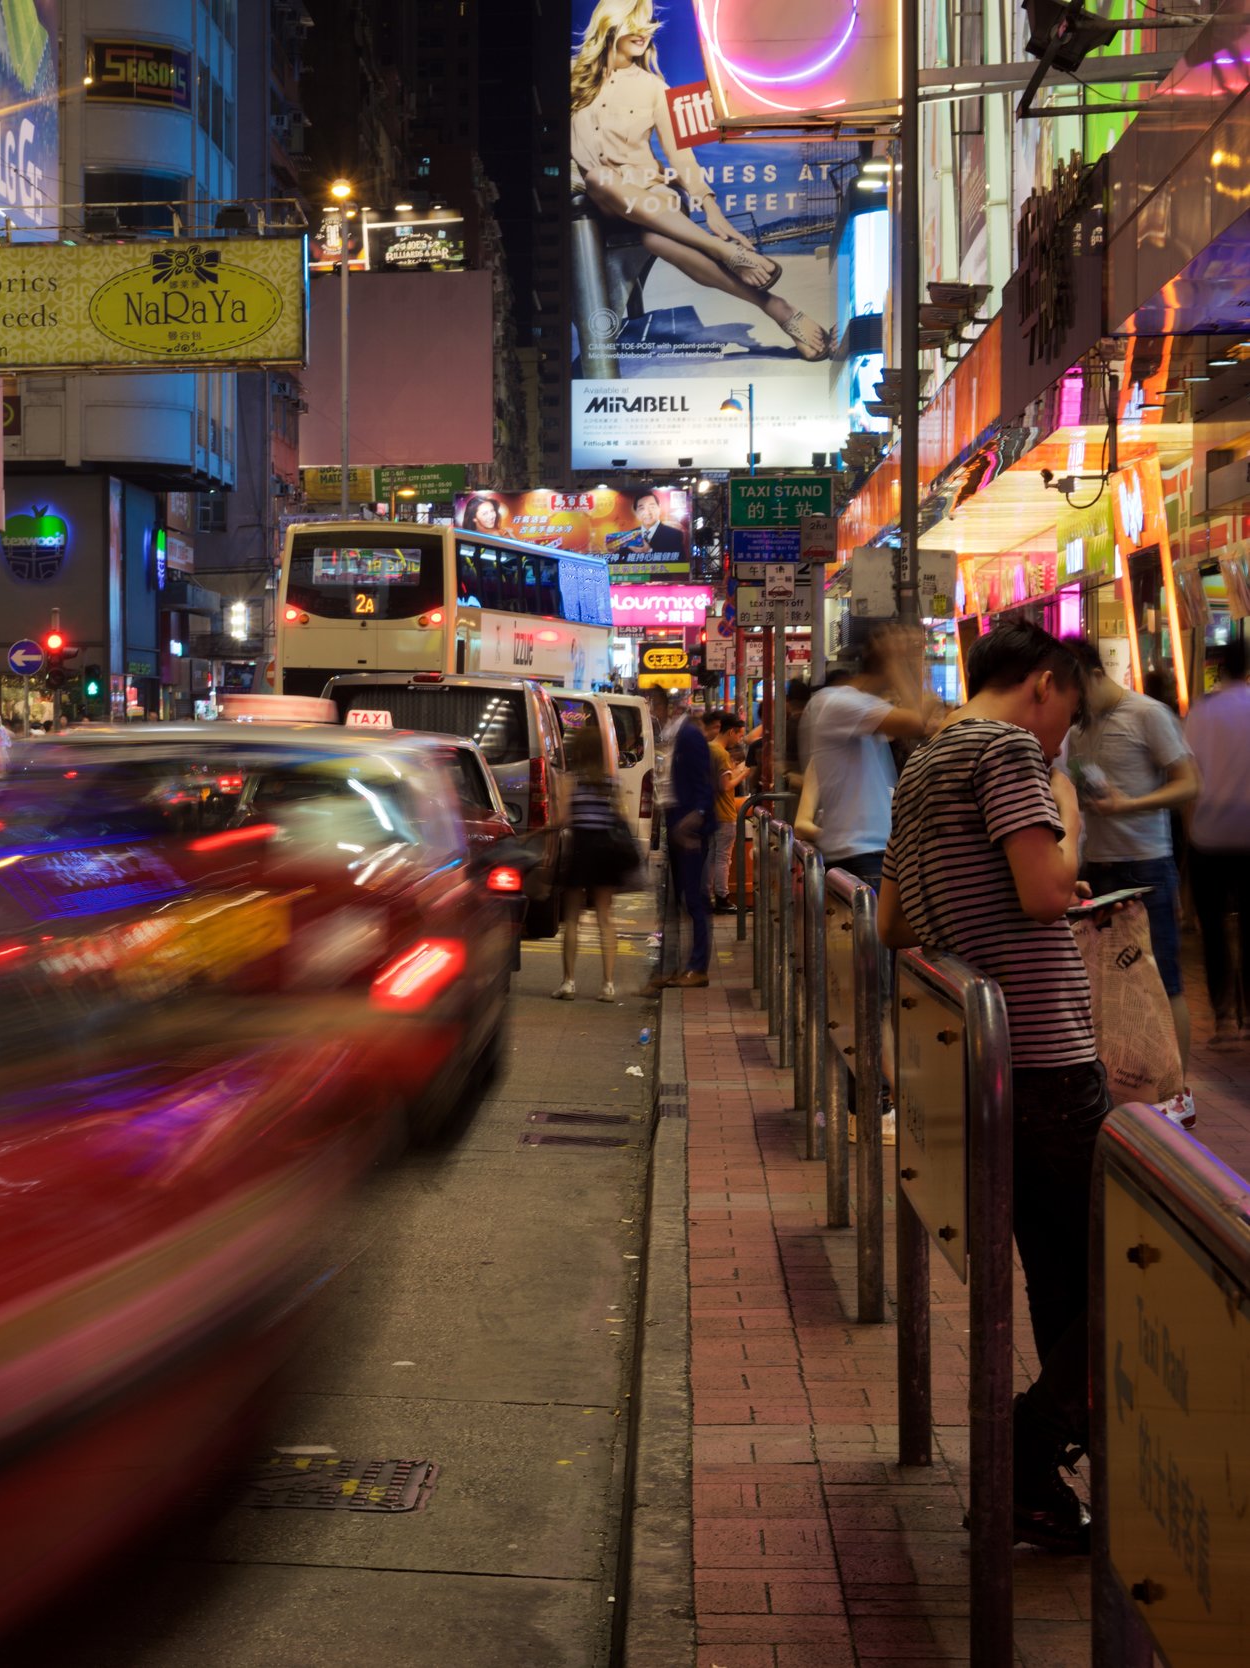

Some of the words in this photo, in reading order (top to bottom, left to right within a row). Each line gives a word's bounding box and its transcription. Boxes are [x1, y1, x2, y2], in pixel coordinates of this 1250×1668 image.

[598, 163, 778, 187] HAPPINESS
[799, 163, 832, 182] AT
[625, 193, 704, 215] YOUR
[725, 191, 798, 212] FEET
[124, 289, 248, 327] NaRaYa
[621, 342, 655, 350] TOE-POST
[656, 342, 672, 350] with
[672, 342, 725, 352] patent-pending
[657, 350, 683, 359] comfort
[684, 350, 725, 361] technology
[583, 386, 619, 394] Available
[620, 386, 630, 394] at
[738, 486, 770, 497] TAXI
[774, 485, 823, 497] STAND
[747, 500, 814, 520] 的士站
[810, 522, 828, 530] 2nd
[2, 532, 64, 548] texwood
[355, 593, 375, 613] 2A
[351, 713, 390, 726] TAXI
